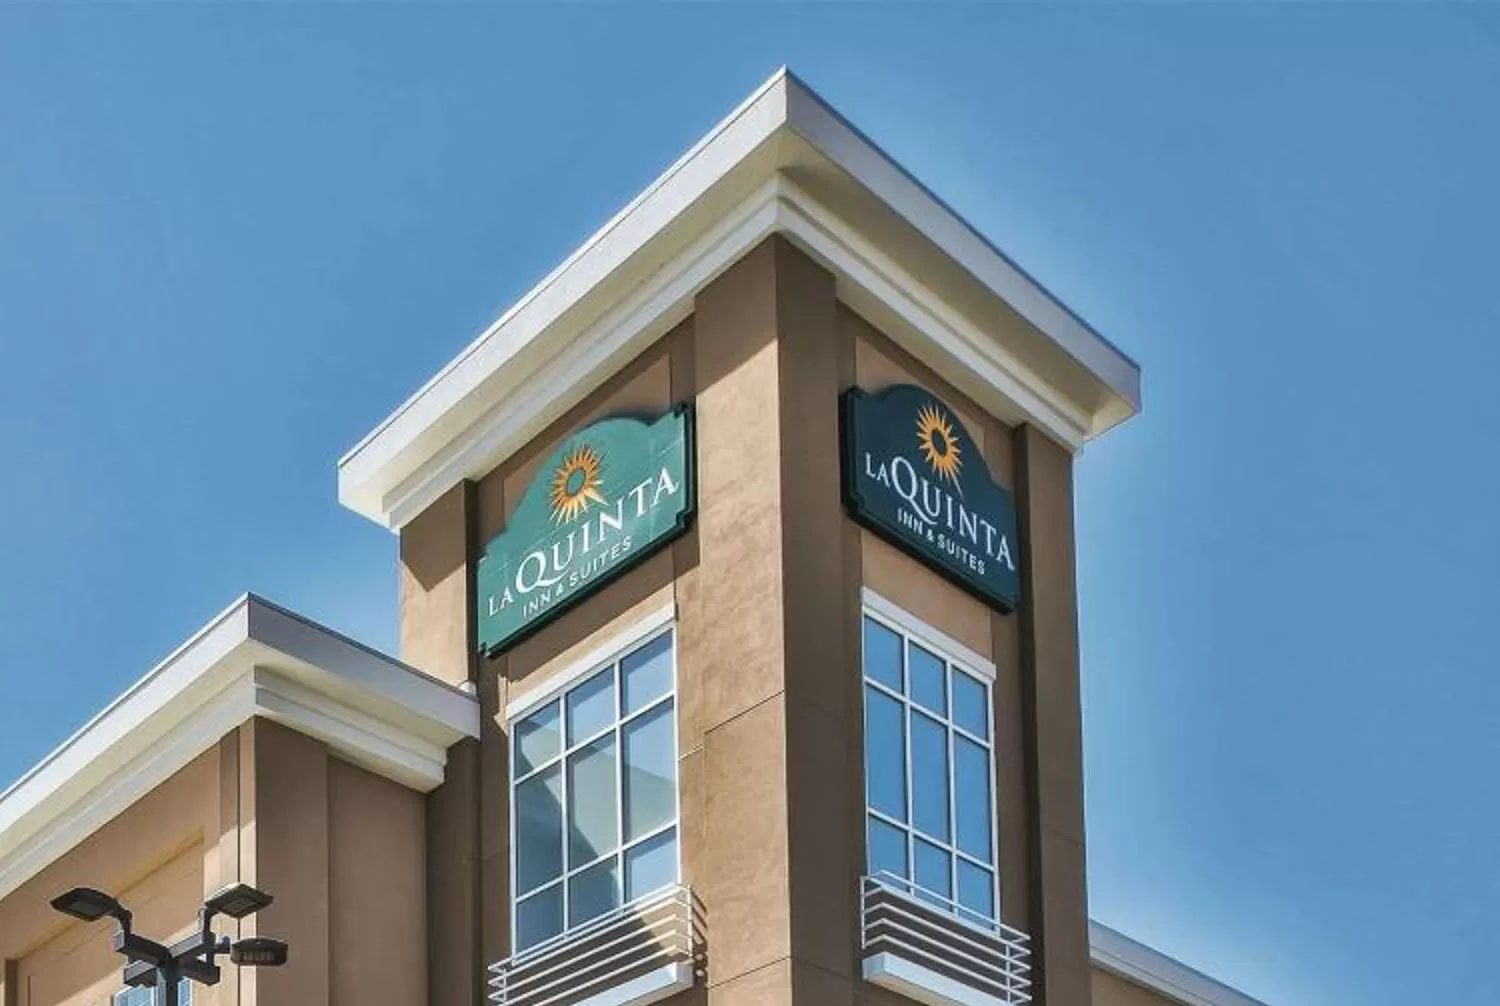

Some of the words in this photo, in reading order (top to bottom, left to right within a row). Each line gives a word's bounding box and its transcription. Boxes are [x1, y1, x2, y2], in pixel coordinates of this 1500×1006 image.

[488, 586, 514, 616] LA
[515, 466, 679, 593] QUINTA
[865, 452, 891, 489] LA
[892, 456, 1015, 572] QUINTA
[897, 507, 923, 535] INN
[926, 528, 935, 542] &
[937, 533, 985, 576] SUITES
[523, 588, 551, 618] INN
[555, 583, 565, 597] &
[569, 534, 633, 587] SUITES
